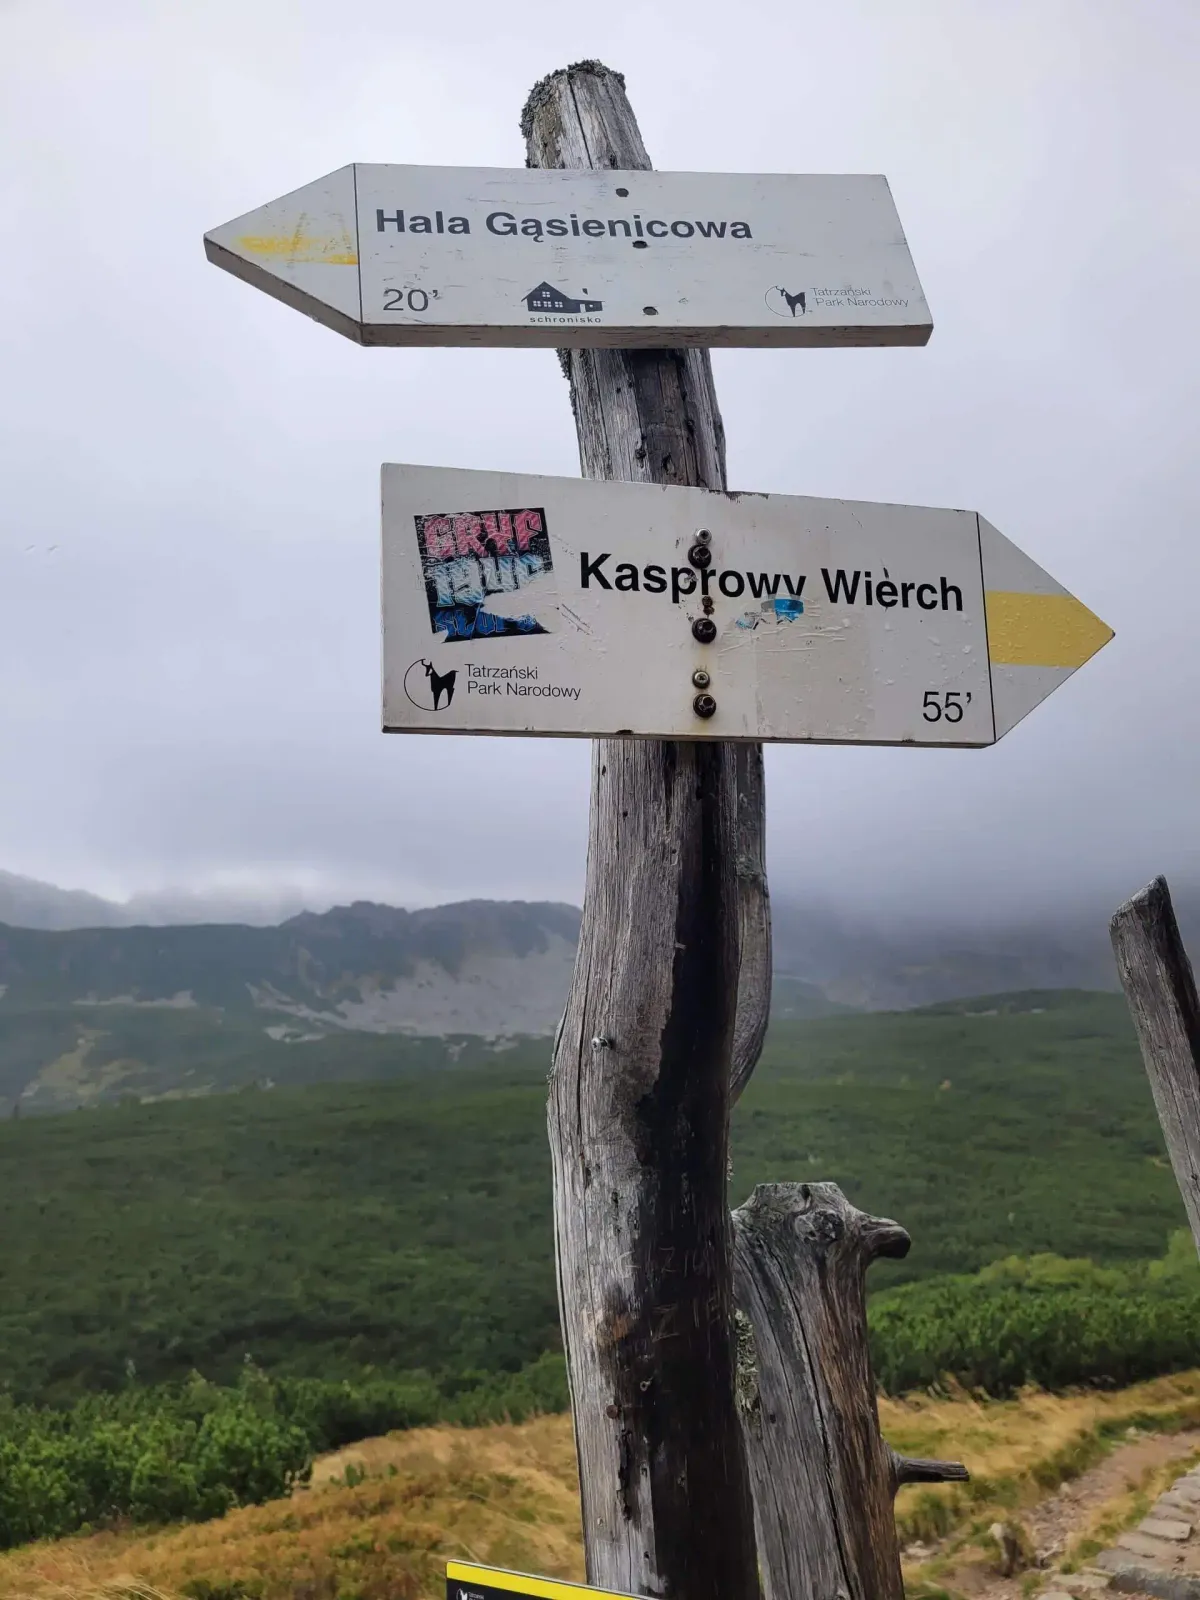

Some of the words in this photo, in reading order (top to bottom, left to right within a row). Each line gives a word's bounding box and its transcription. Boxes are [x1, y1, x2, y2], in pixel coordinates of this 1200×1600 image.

[376, 208, 471, 235] Hala
[485, 211, 753, 243] Gąsienicowa
[810, 286, 872, 297] Tatrzański
[815, 297, 845, 307] Park
[847, 297, 910, 308] Narodowy
[529, 315, 602, 324] schronisko
[820, 567, 964, 612] Wierch
[464, 663, 539, 680] Tatrzański
[467, 680, 502, 696] Park
[506, 682, 582, 701] Narodowy
